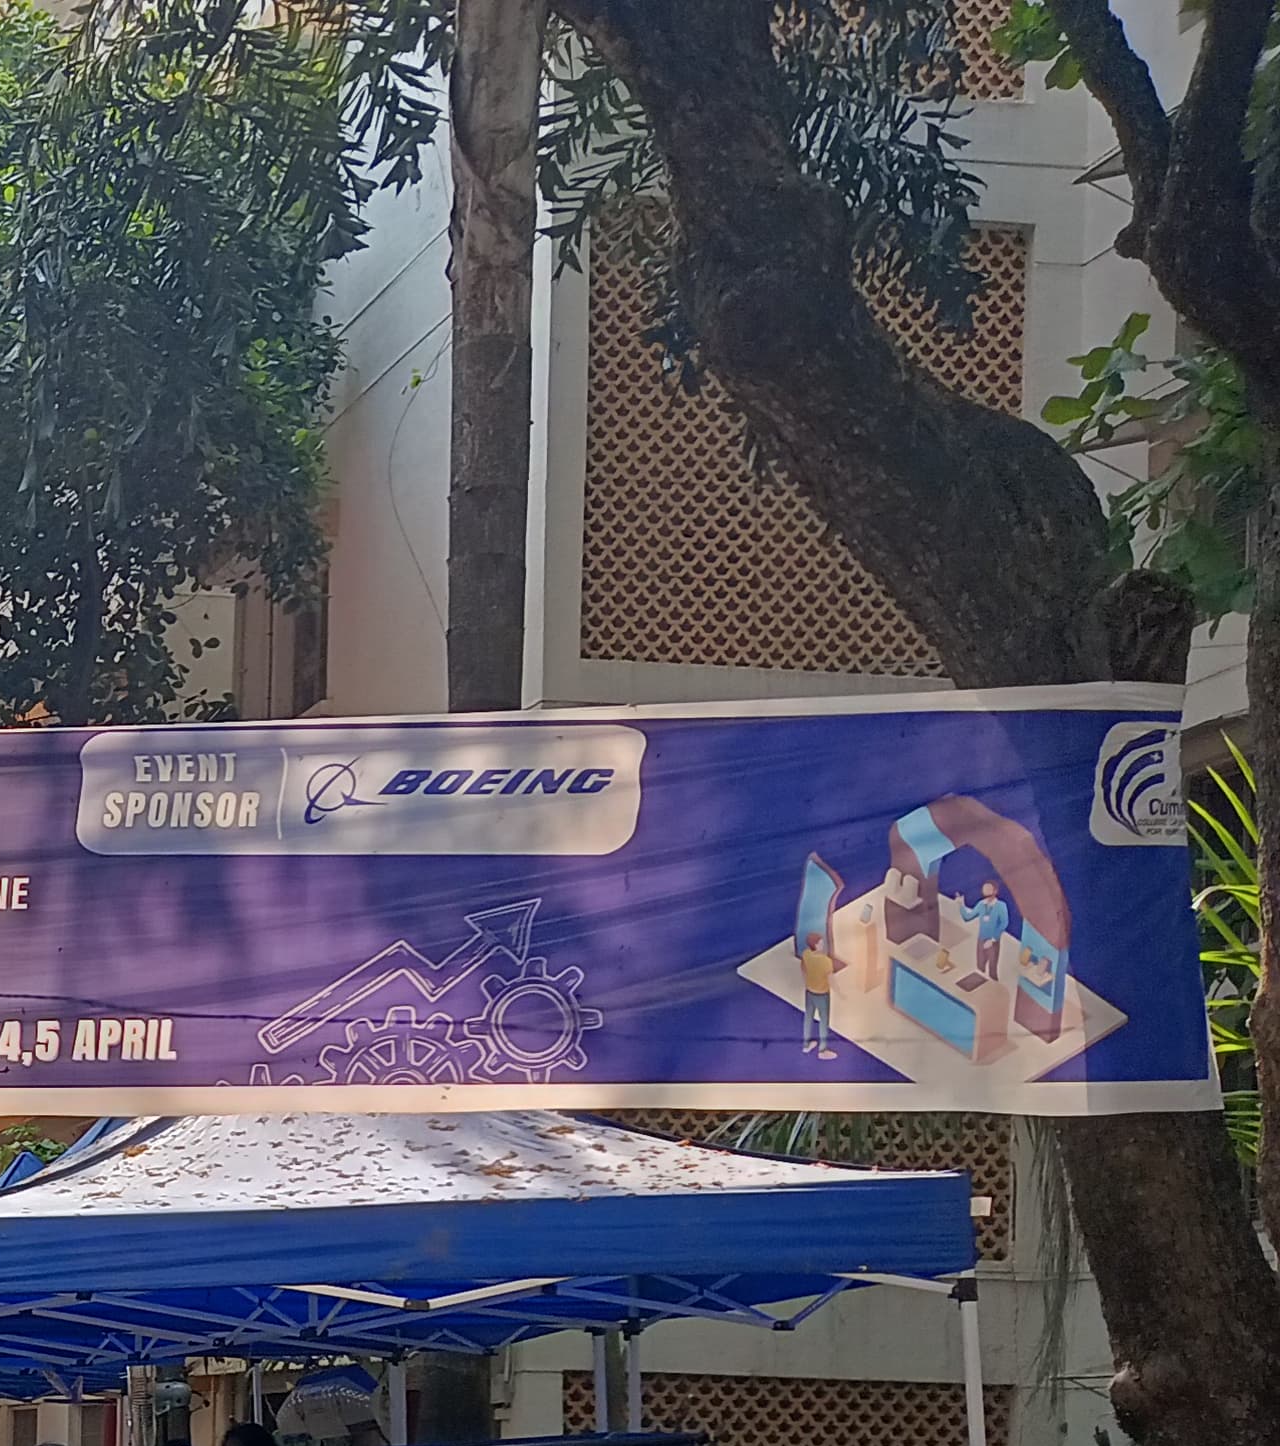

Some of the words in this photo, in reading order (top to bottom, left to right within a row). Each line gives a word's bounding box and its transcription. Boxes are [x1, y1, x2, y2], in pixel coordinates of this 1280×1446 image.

[133, 752, 237, 784] EVENT
[377, 767, 615, 796] BOEING
[102, 791, 260, 829] SPONSOR
[72, 1018, 177, 1063] APRIL
